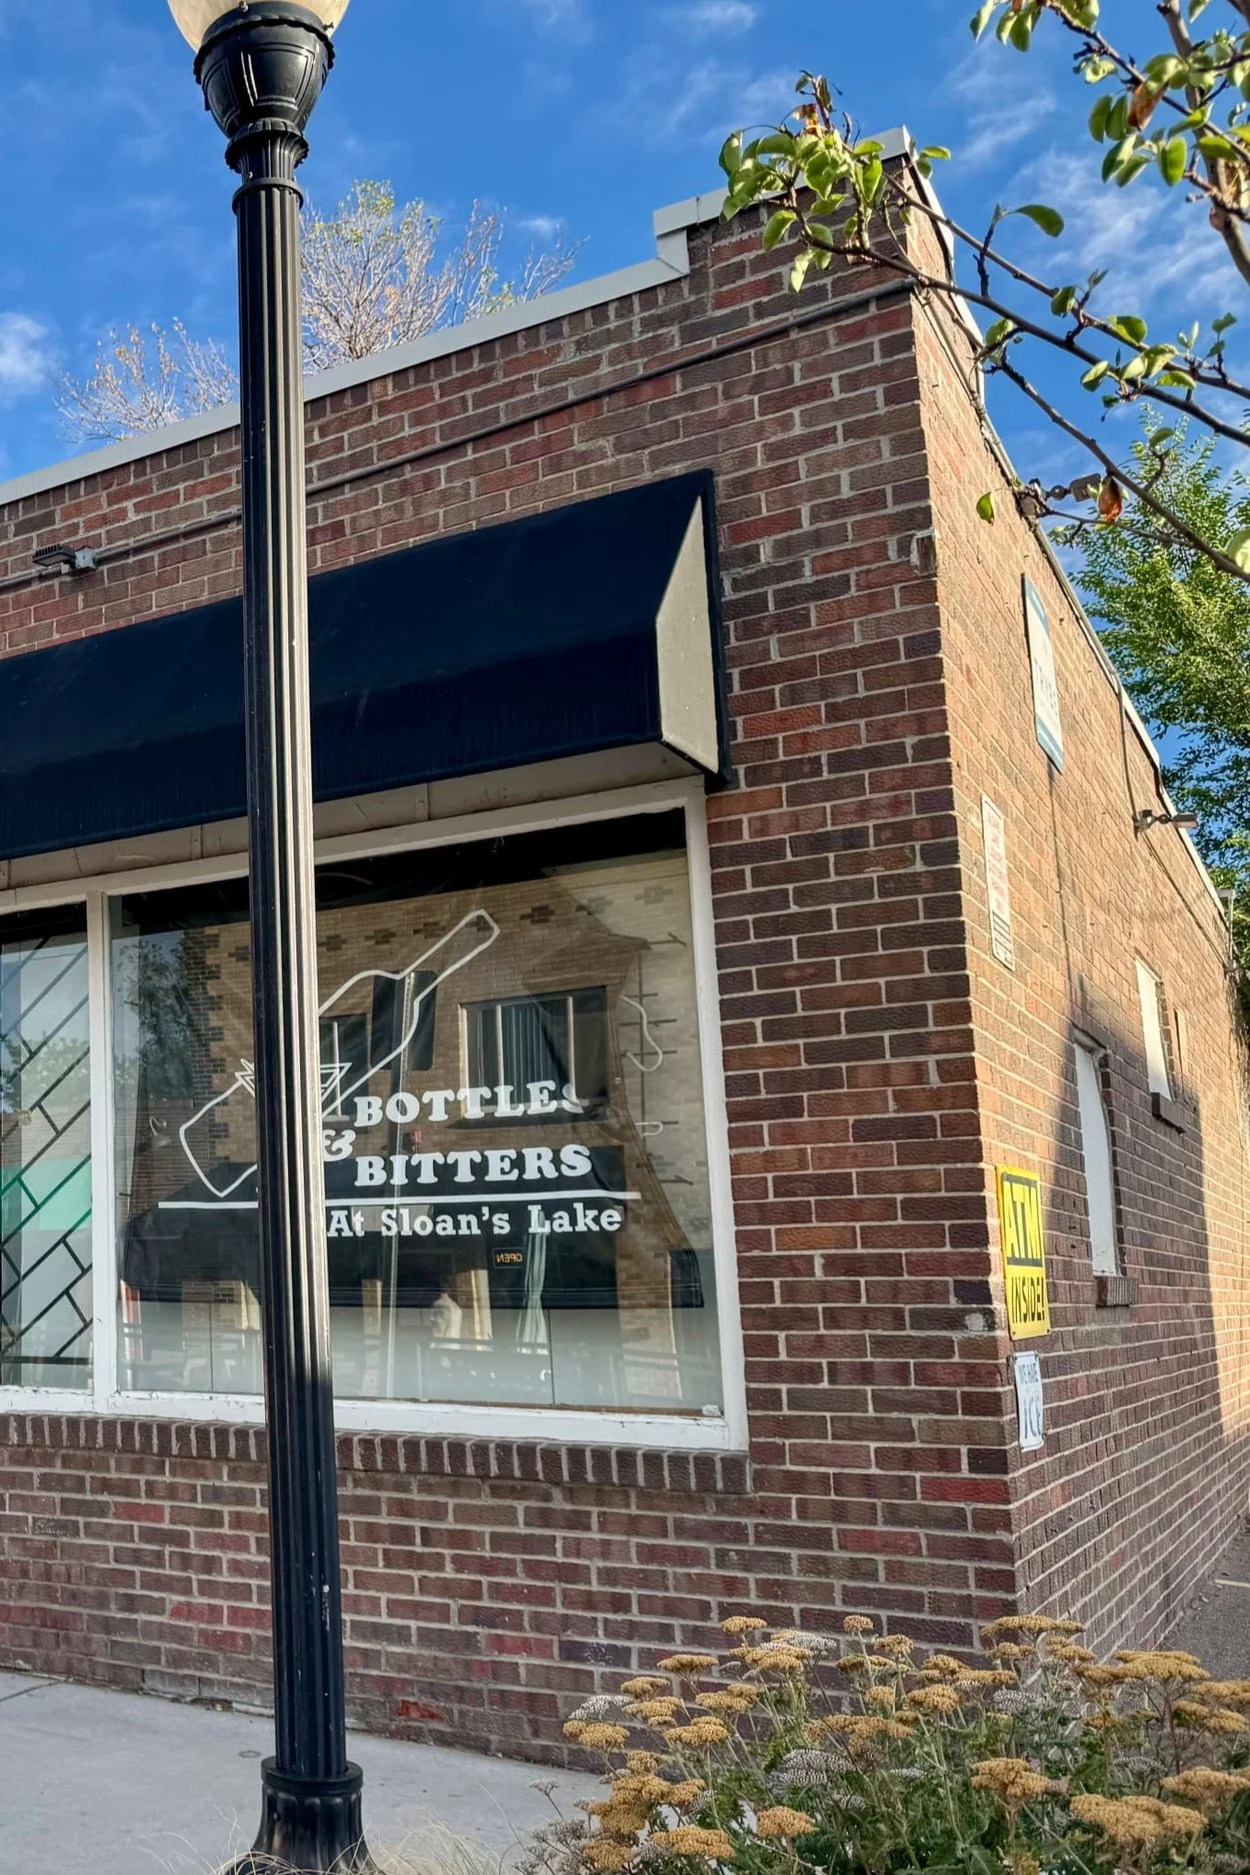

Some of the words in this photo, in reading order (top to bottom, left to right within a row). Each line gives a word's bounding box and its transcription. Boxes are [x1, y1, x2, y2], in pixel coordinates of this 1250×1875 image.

[353, 1080, 585, 1128] BOTTLES
[323, 1129, 357, 1162] &
[354, 1144, 593, 1187] BITTERS
[327, 1208, 365, 1237] At
[381, 1205, 511, 1237] Sloan's
[527, 1202, 622, 1234] Lake
[1003, 1180, 1042, 1260] ATM
[1011, 1276, 1045, 1325] INSIDE!
